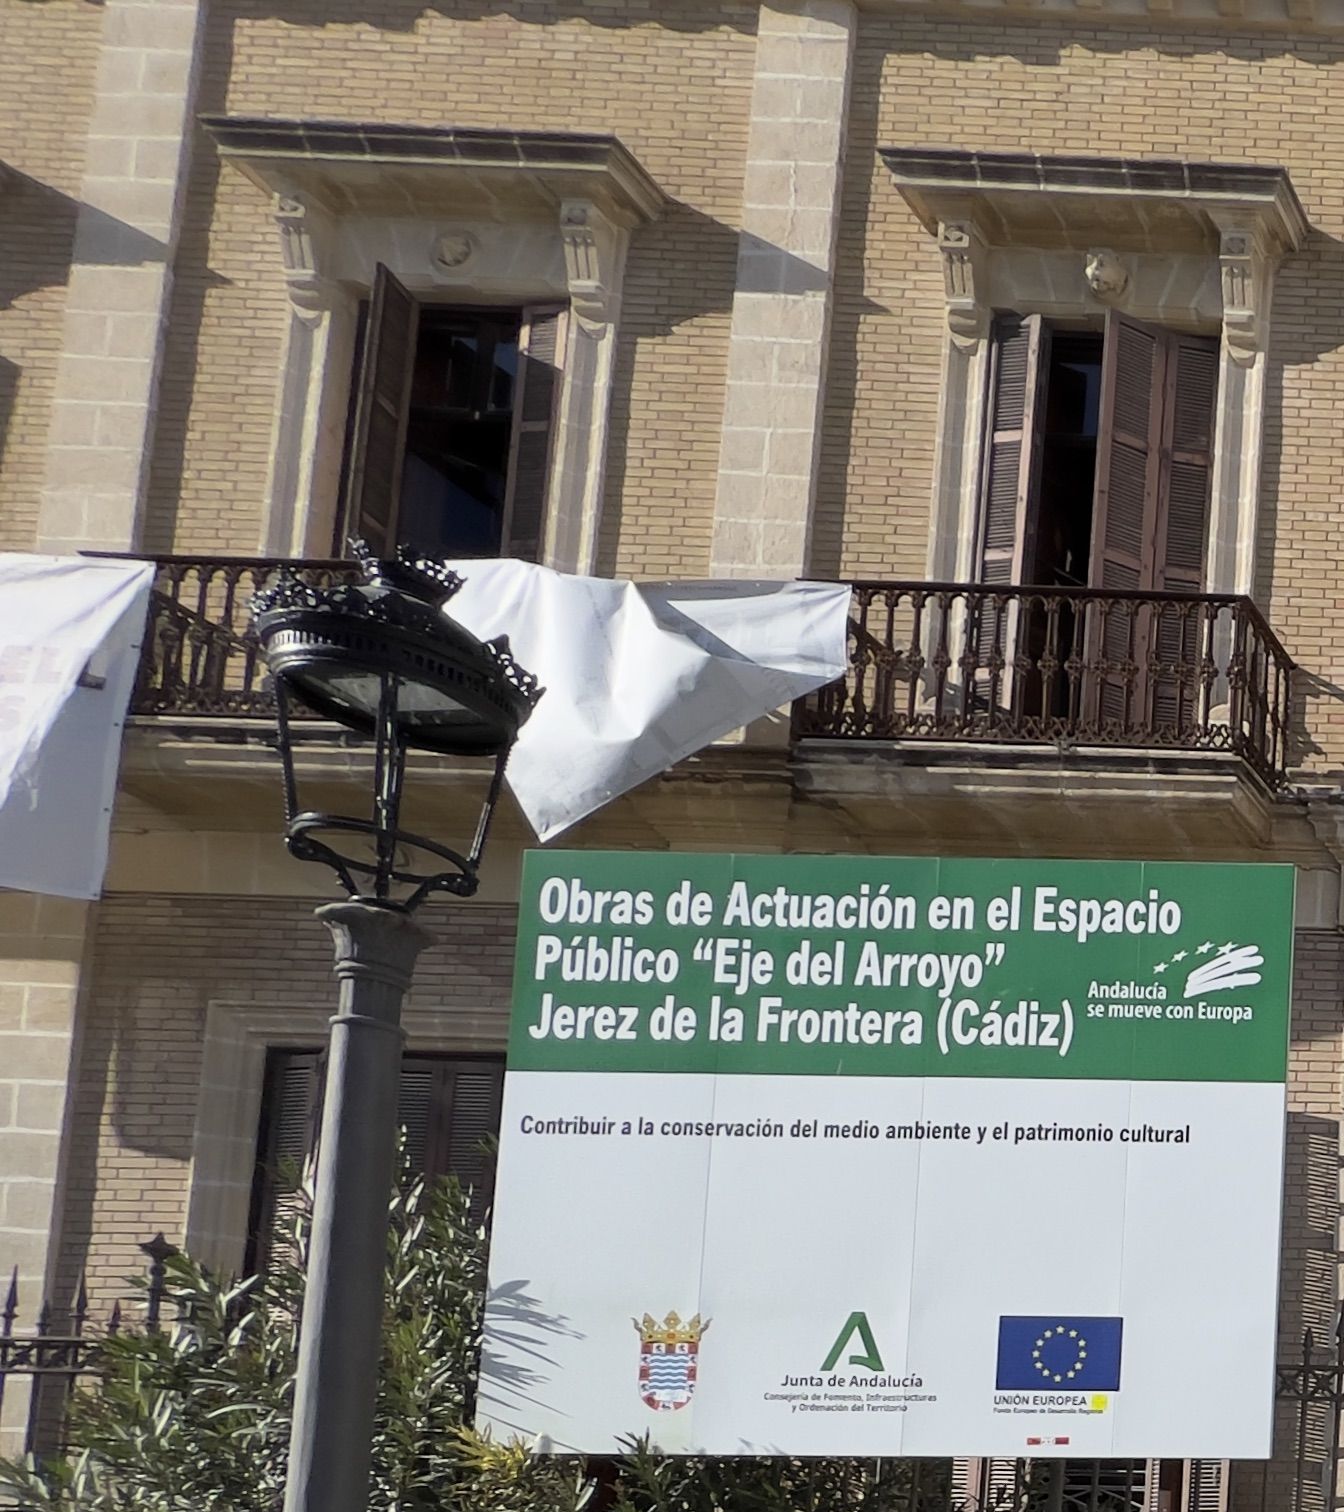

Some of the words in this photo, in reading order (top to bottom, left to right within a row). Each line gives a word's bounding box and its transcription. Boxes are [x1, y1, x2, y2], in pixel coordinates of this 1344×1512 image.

[539, 877, 654, 926] Obras
[665, 880, 713, 926] de
[723, 880, 915, 931] Actuación
[927, 894, 975, 931] en
[986, 886, 1022, 931] el
[1033, 886, 1182, 943] Espacio
[535, 935, 680, 983] Público
[786, 940, 845, 985] del
[1087, 981, 1167, 1000] Andalucía
[1087, 1003, 1105, 1018] se
[1108, 1004, 1163, 1019] mueve
[1165, 1004, 1194, 1020] con
[1198, 1002, 1253, 1024] Europa
[529, 993, 640, 1040] Jerez
[649, 995, 697, 1041] de
[709, 996, 744, 1042] la
[757, 996, 923, 1044] Frontera
[937, 998, 1074, 1057] (Cádiz)
[520, 1115, 616, 1136] Contribuir
[621, 1121, 632, 1136] a
[638, 1117, 654, 1136] la
[661, 1118, 784, 1138] conservación
[790, 1119, 817, 1138] del
[824, 1119, 880, 1139] medio
[885, 1121, 971, 1140] ambiente
[977, 1125, 988, 1144] y
[992, 1122, 1008, 1140] el
[1014, 1123, 1114, 1145] patrimonio
[1120, 1124, 1190, 1144] cultural
[781, 1374, 824, 1387] Junta
[827, 1374, 846, 1387] de
[850, 1373, 923, 1388] Andalucía
[811, 1392, 822, 1401] de
[993, 1393, 1030, 1405] UNIÓN
[1032, 1395, 1087, 1405] EUROPEA
[792, 1405, 797, 1413] y
[851, 1403, 864, 1412] del
